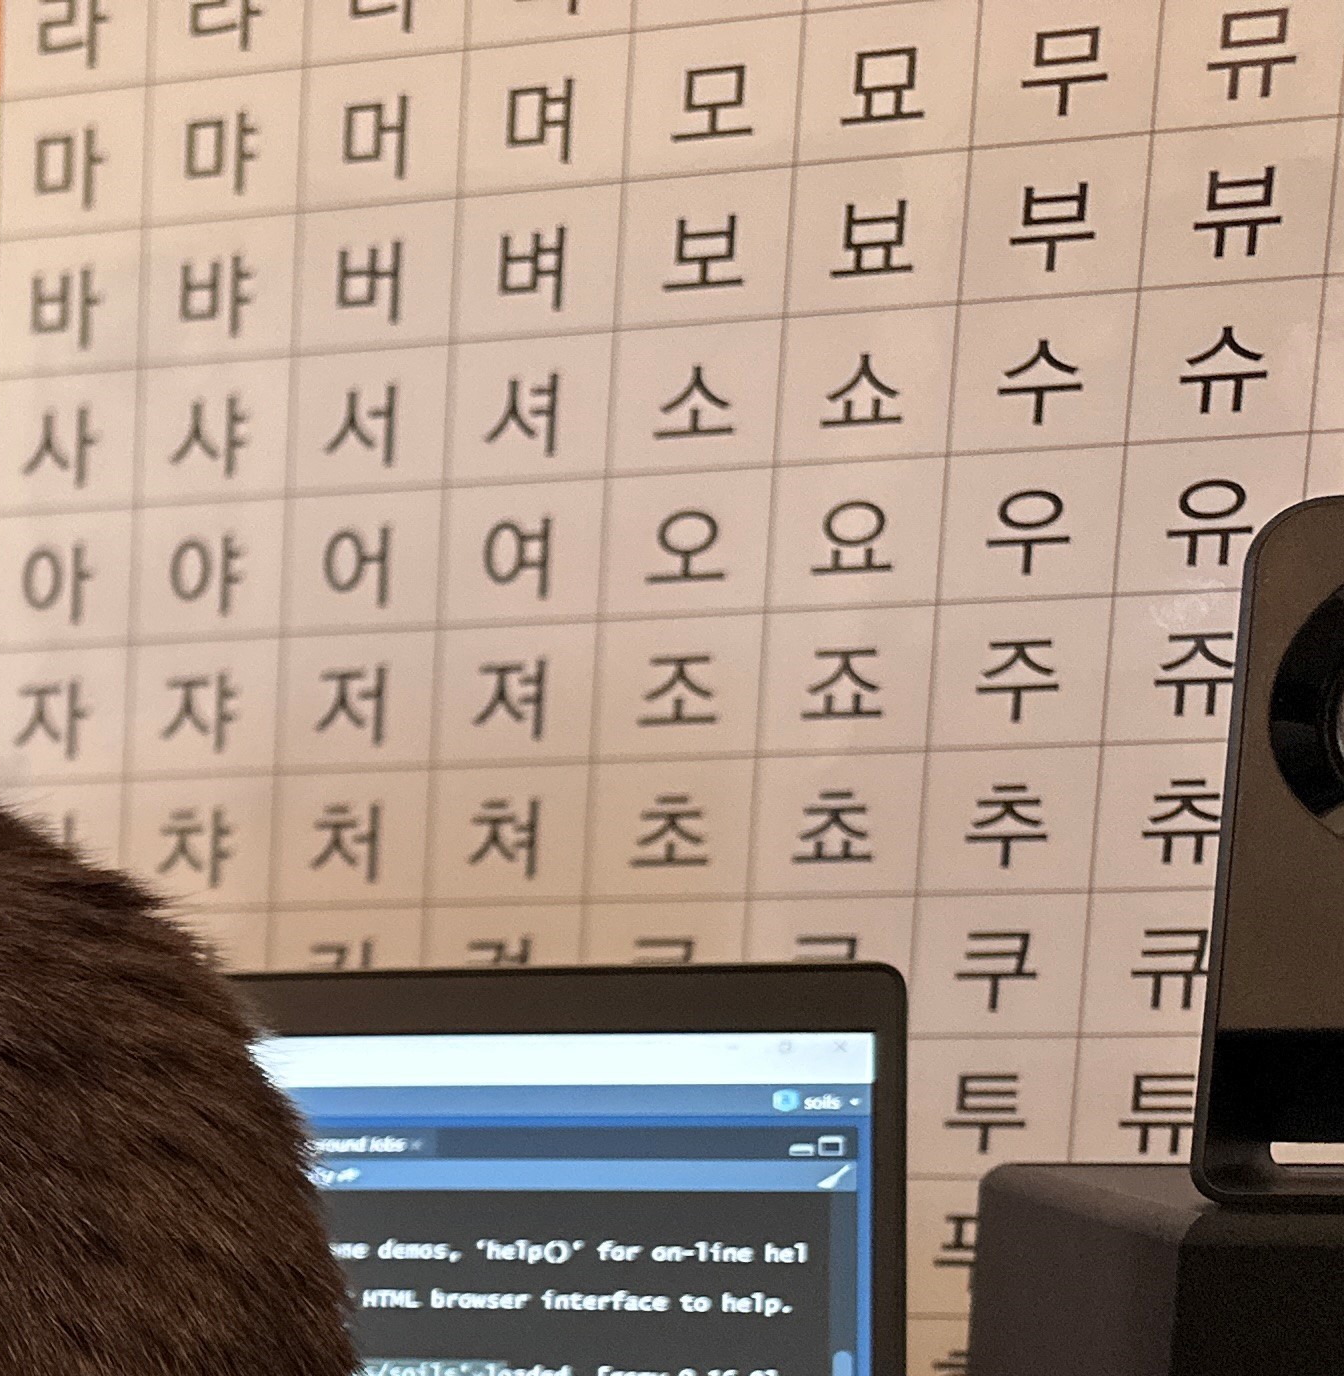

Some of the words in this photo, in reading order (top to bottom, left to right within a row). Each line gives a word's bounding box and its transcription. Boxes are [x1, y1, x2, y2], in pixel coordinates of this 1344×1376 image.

[35, 128, 104, 209] 마
[185, 111, 257, 195] 먀
[344, 95, 408, 179] 머
[507, 82, 573, 163] 며
[671, 64, 753, 142] 모
[841, 47, 924, 126] 묘
[1022, 27, 1108, 116] 무
[1207, 8, 1297, 100] 뮤
[32, 269, 100, 349] 바
[180, 255, 251, 337] 뱌
[337, 241, 402, 324] 버
[500, 226, 566, 311] 벼
[663, 214, 744, 291] 보
[830, 200, 913, 278] 뵤
[1010, 182, 1095, 272] 부
[1194, 166, 1282, 258] 뷰
[24, 407, 97, 488] 사
[171, 395, 246, 478] 샤
[325, 384, 397, 467] 서
[485, 373, 559, 457] 셔
[654, 366, 734, 439] 소
[820, 354, 902, 428] 쇼
[998, 340, 1083, 425] 수
[1180, 326, 1267, 414] 슈
[23, 545, 92, 625] 아
[170, 535, 241, 616] 야
[324, 527, 390, 608] 어
[484, 518, 551, 599] 여
[645, 510, 725, 584] 오
[811, 501, 893, 575] 요
[987, 490, 1070, 575] 우
[1167, 479, 1253, 566] 유
[16, 680, 87, 759] 자
[163, 673, 236, 752] 쟈
[317, 666, 387, 745] 저
[475, 660, 546, 740] 져
[955, 932, 1037, 1012] 쿠
[362, 1289, 419, 1308] HTML
[430, 1288, 531, 1310] browser
[540, 1289, 670, 1312] interface
[679, 1294, 712, 1313] to
[722, 1293, 792, 1317] help.
[378, 1239, 461, 1262] demos,
[596, 1240, 642, 1262] for
[650, 1241, 754, 1263] on-line
